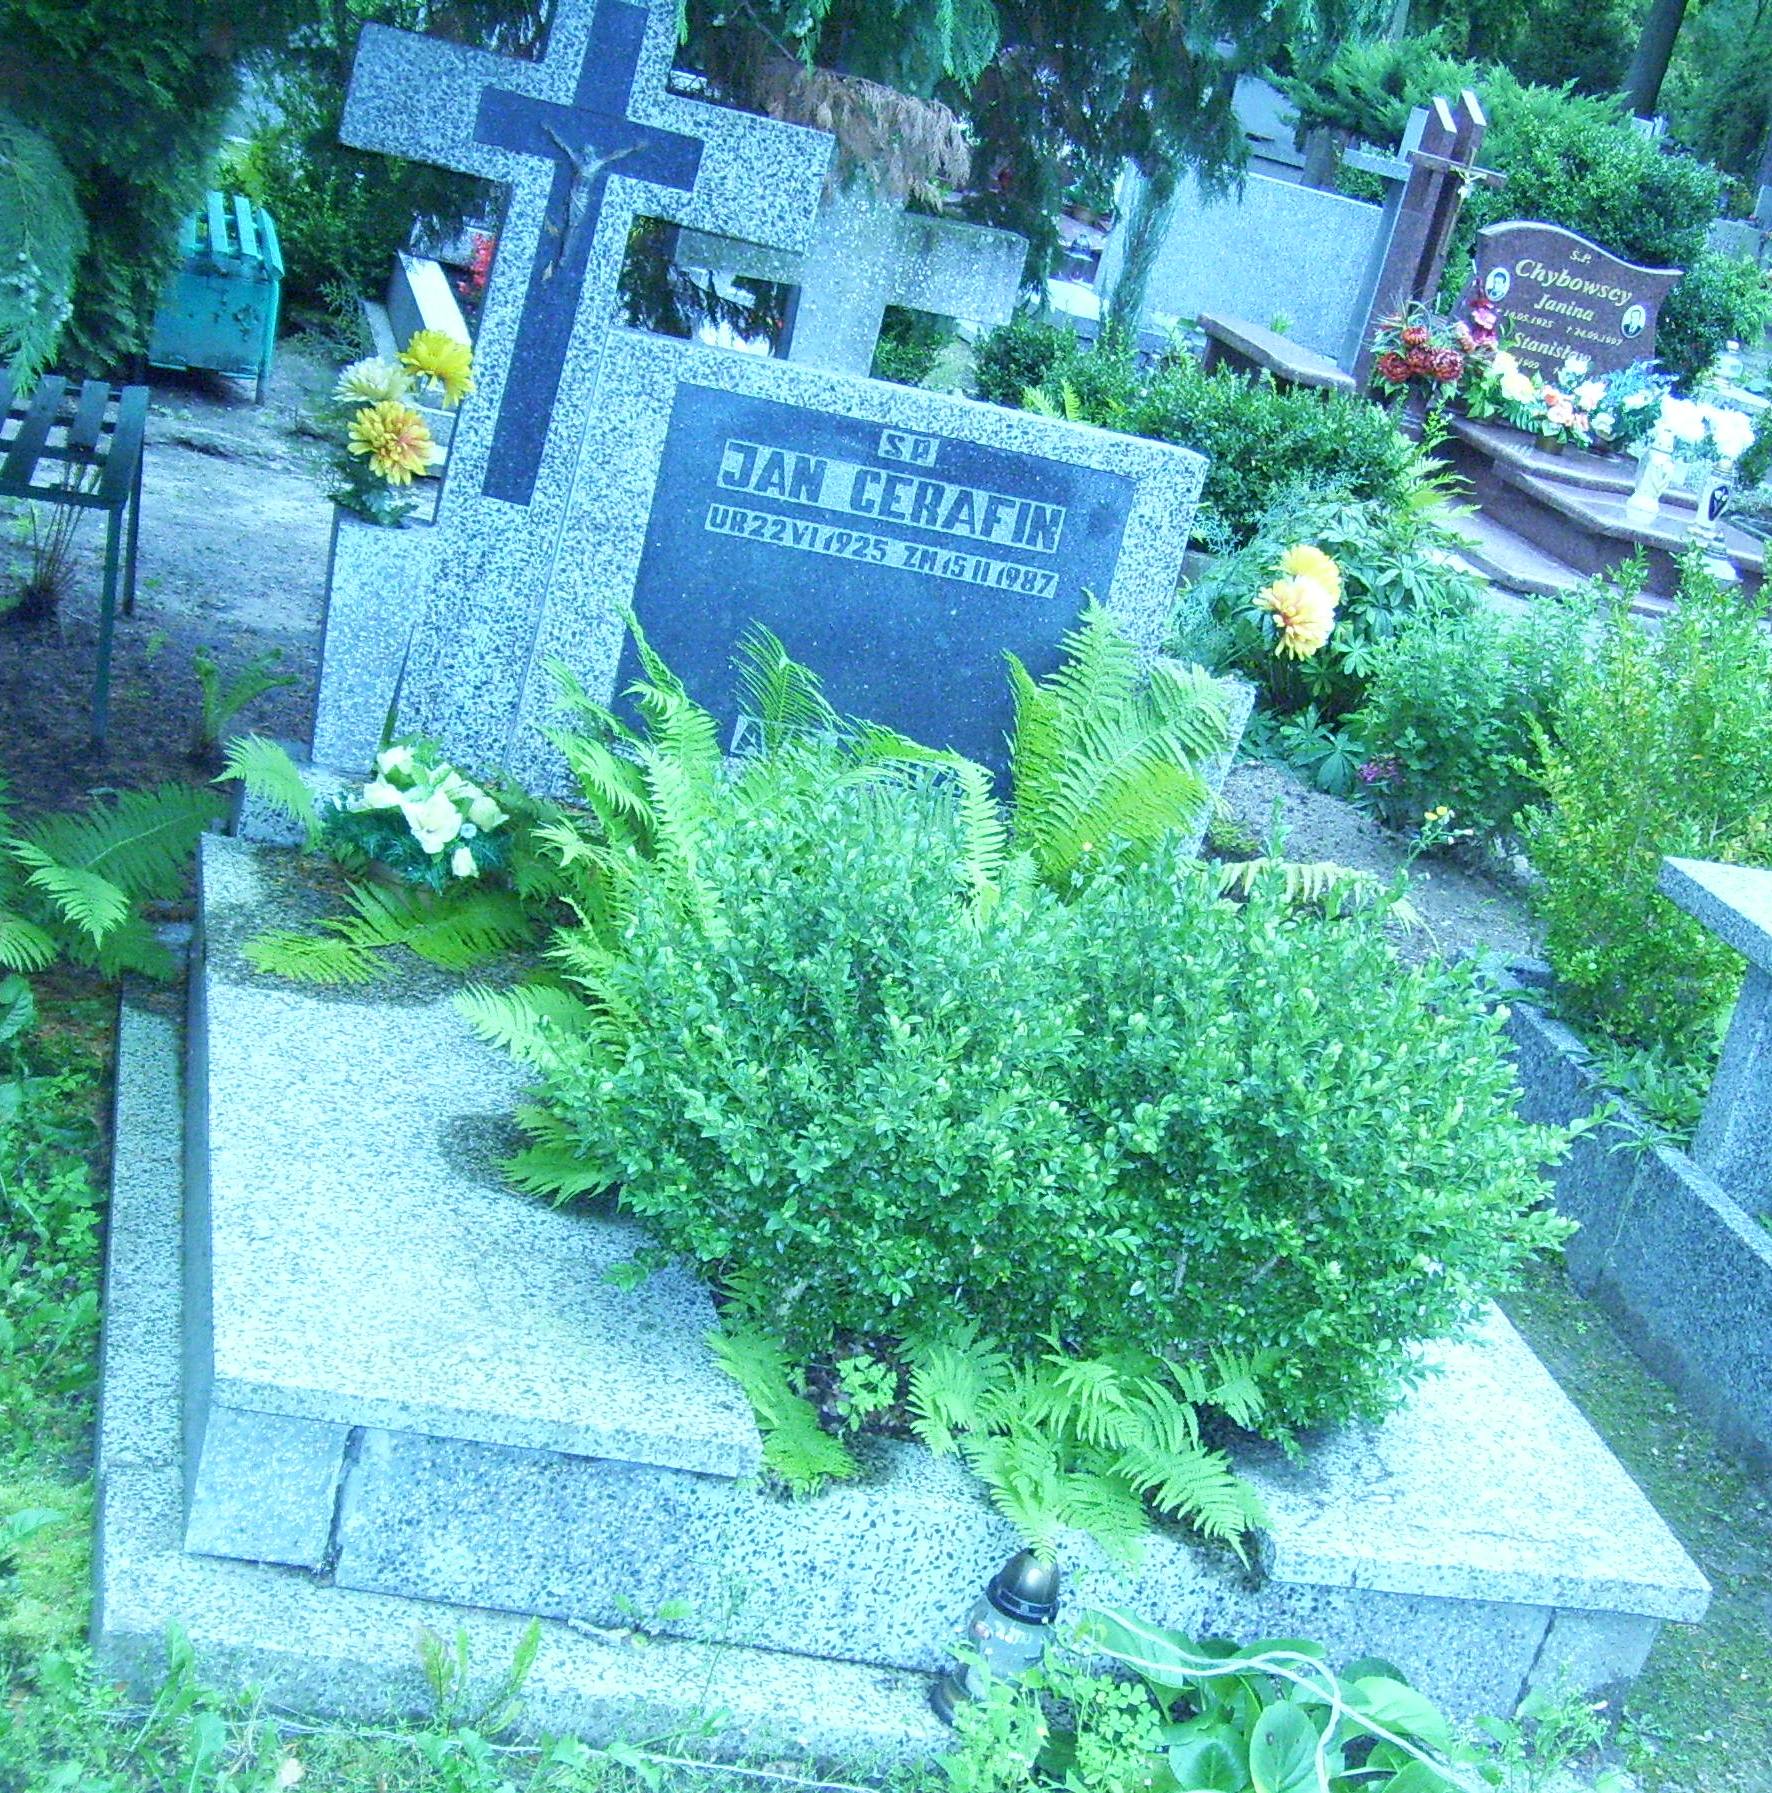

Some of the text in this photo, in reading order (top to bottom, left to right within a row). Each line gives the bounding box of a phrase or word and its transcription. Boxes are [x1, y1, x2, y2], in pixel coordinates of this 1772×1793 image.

[1515, 258, 1632, 306] Chybowscy
[1533, 293, 1596, 322] Janina
[721, 440, 1063, 551] JAN CERAFIN
